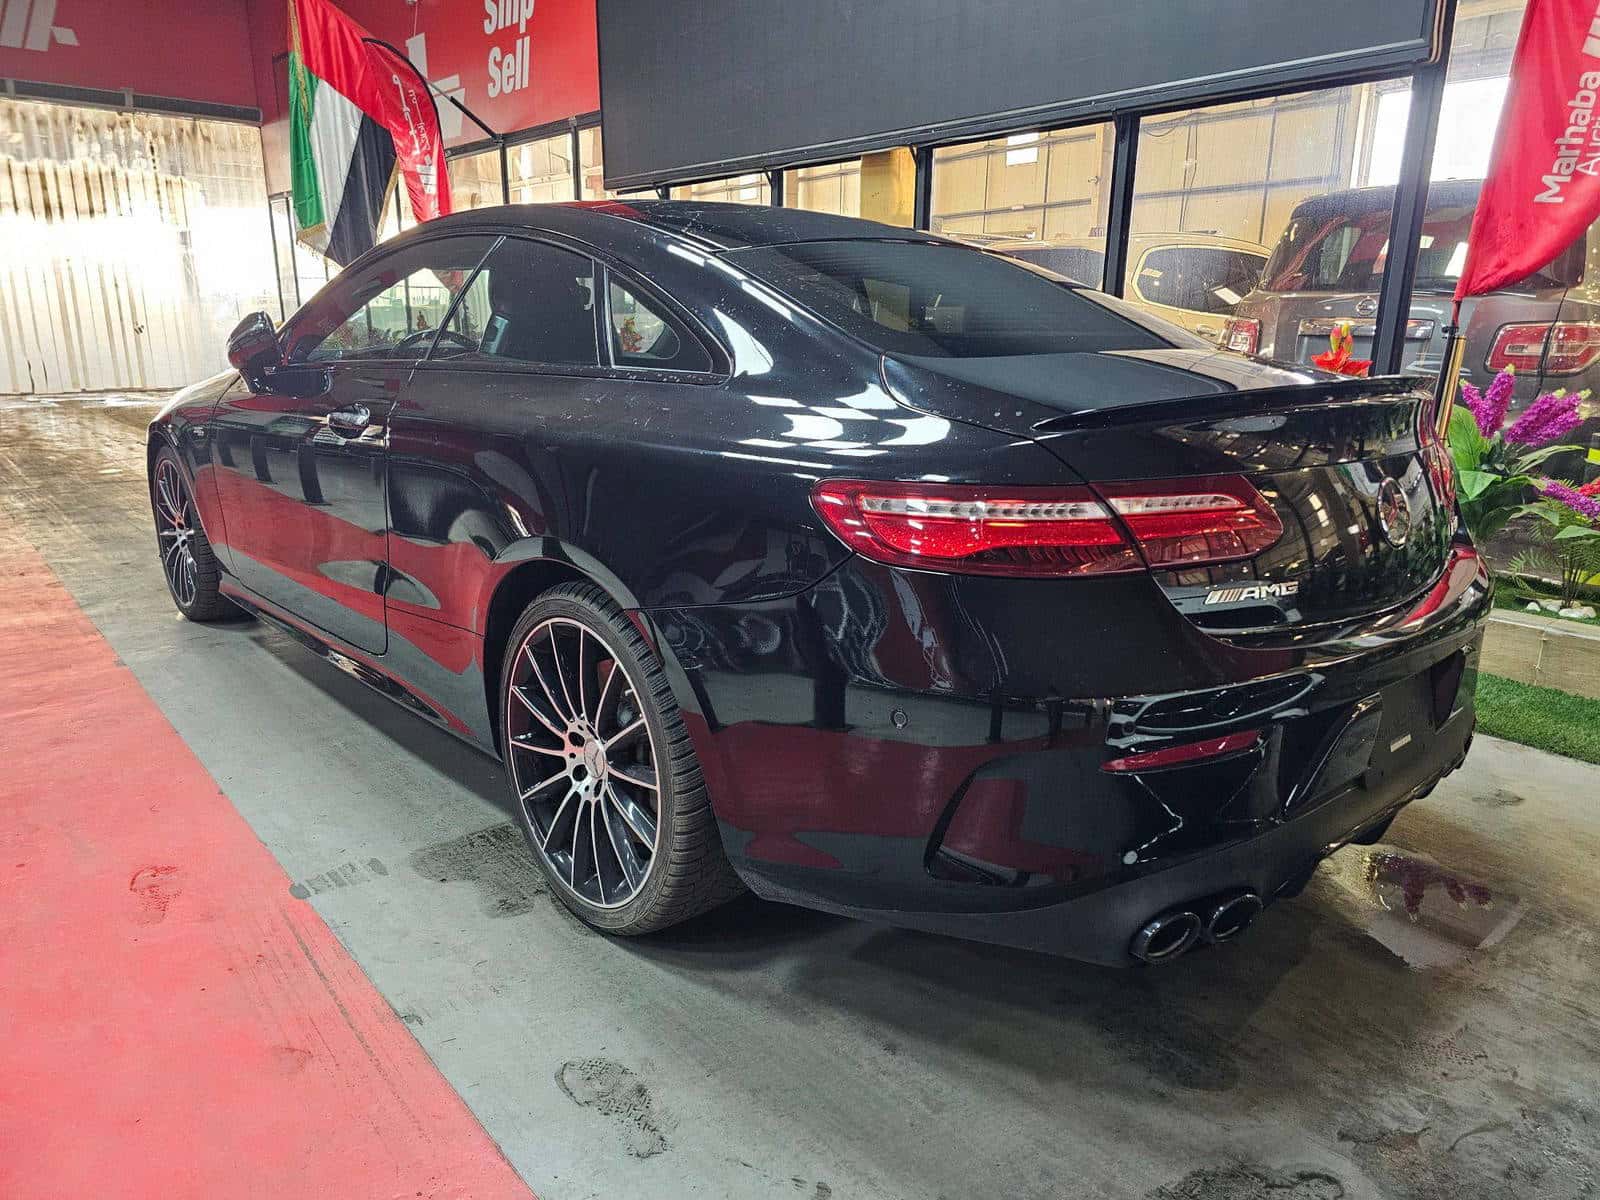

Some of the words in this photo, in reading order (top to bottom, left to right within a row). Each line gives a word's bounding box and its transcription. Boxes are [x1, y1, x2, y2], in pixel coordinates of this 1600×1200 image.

[487, 36, 531, 98] Sell
[1534, 71, 1600, 204] Marhaba
[1239, 581, 1299, 601] AMG
